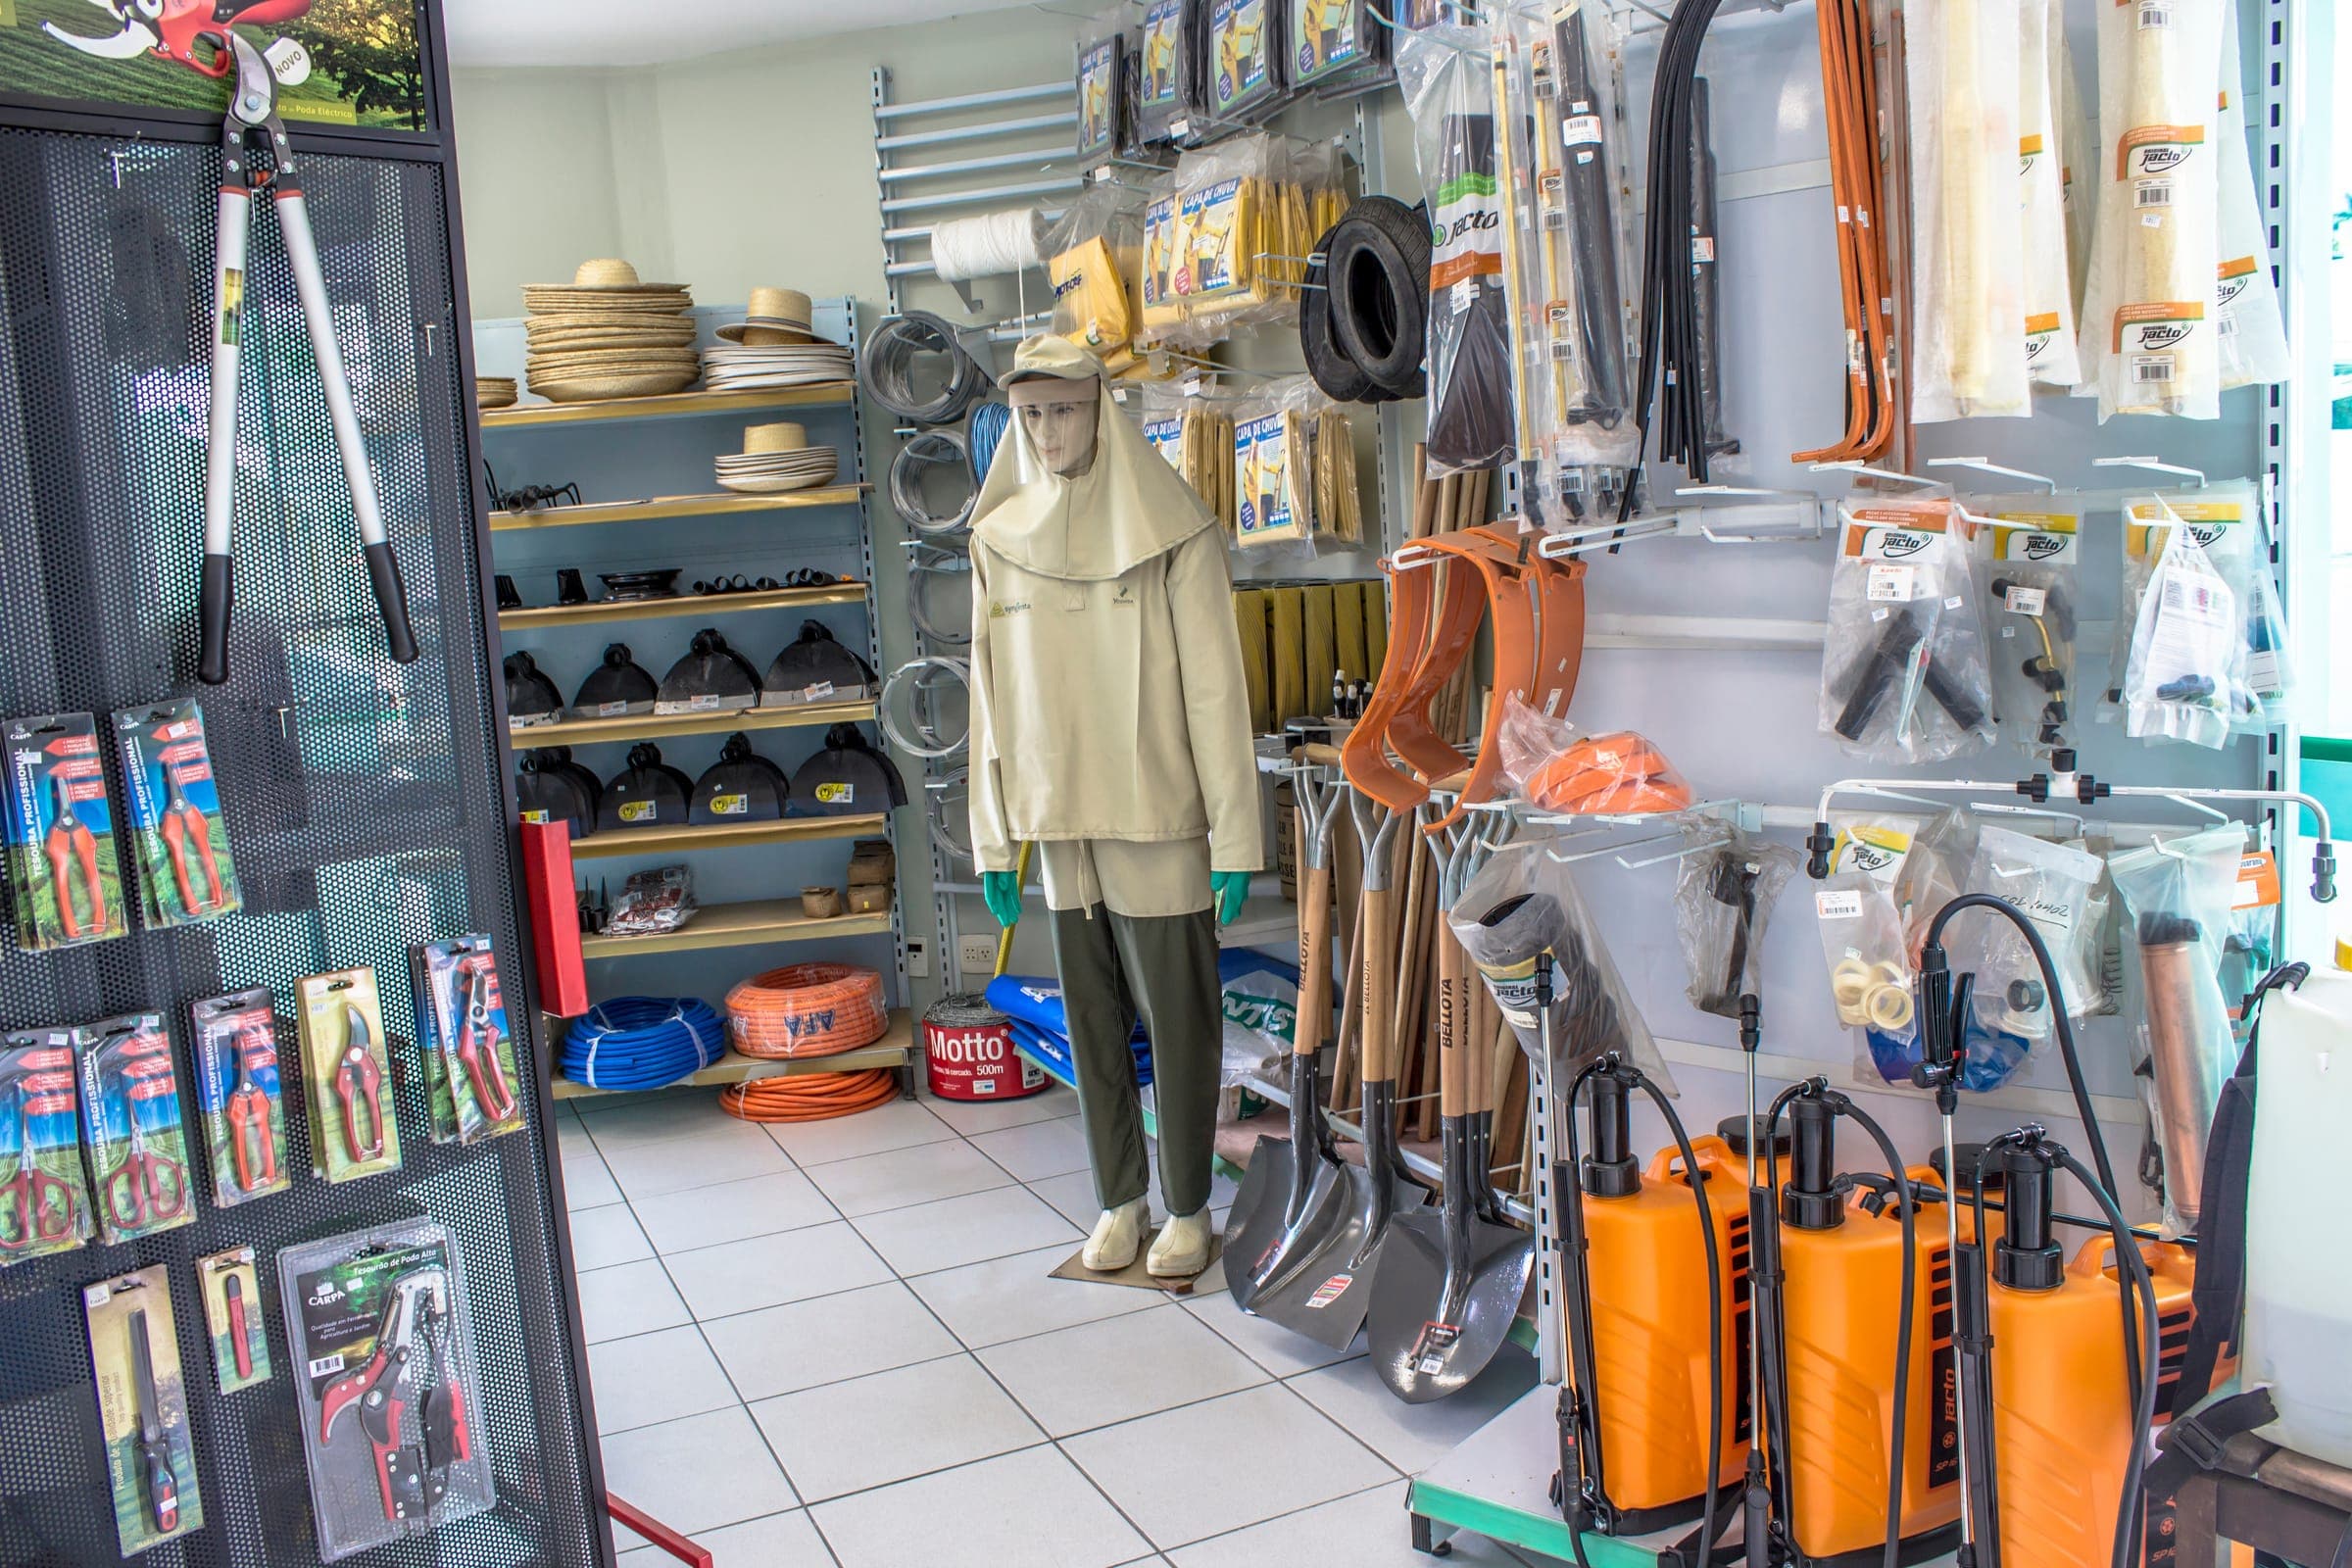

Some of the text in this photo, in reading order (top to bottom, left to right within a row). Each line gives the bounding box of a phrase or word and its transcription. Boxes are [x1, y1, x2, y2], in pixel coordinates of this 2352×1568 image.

[274, 51, 302, 76] NOVO
[296, 105, 316, 115] Poda
[1184, 179, 1237, 208] CAPA DE CHUVA
[1144, 425, 1158, 437] CAPA
[1159, 423, 1167, 434] DE
[1237, 427, 1252, 442] CAPA
[1252, 423, 1261, 435] DE
[14, 747, 35, 828] PROFISSIONAL
[124, 736, 147, 811] PROFISSIONAL
[141, 811, 162, 860] TESOURA
[24, 829, 44, 878] TESOURA
[1298, 930, 1311, 993] BELLOTA
[1442, 977, 1454, 1050] BELLOTA
[976, 1064, 1004, 1076] 500m
[82, 1050, 109, 1176] TESOURA PROFISSIONAL
[212, 1096, 224, 1143] TESOURA
[354, 1261, 389, 1276] Tesourão
[389, 1257, 400, 1267] de
[401, 1253, 420, 1264] Poda
[308, 1290, 346, 1306] CARPA
[109, 1448, 122, 1460] de
[113, 1460, 125, 1492] Produto
